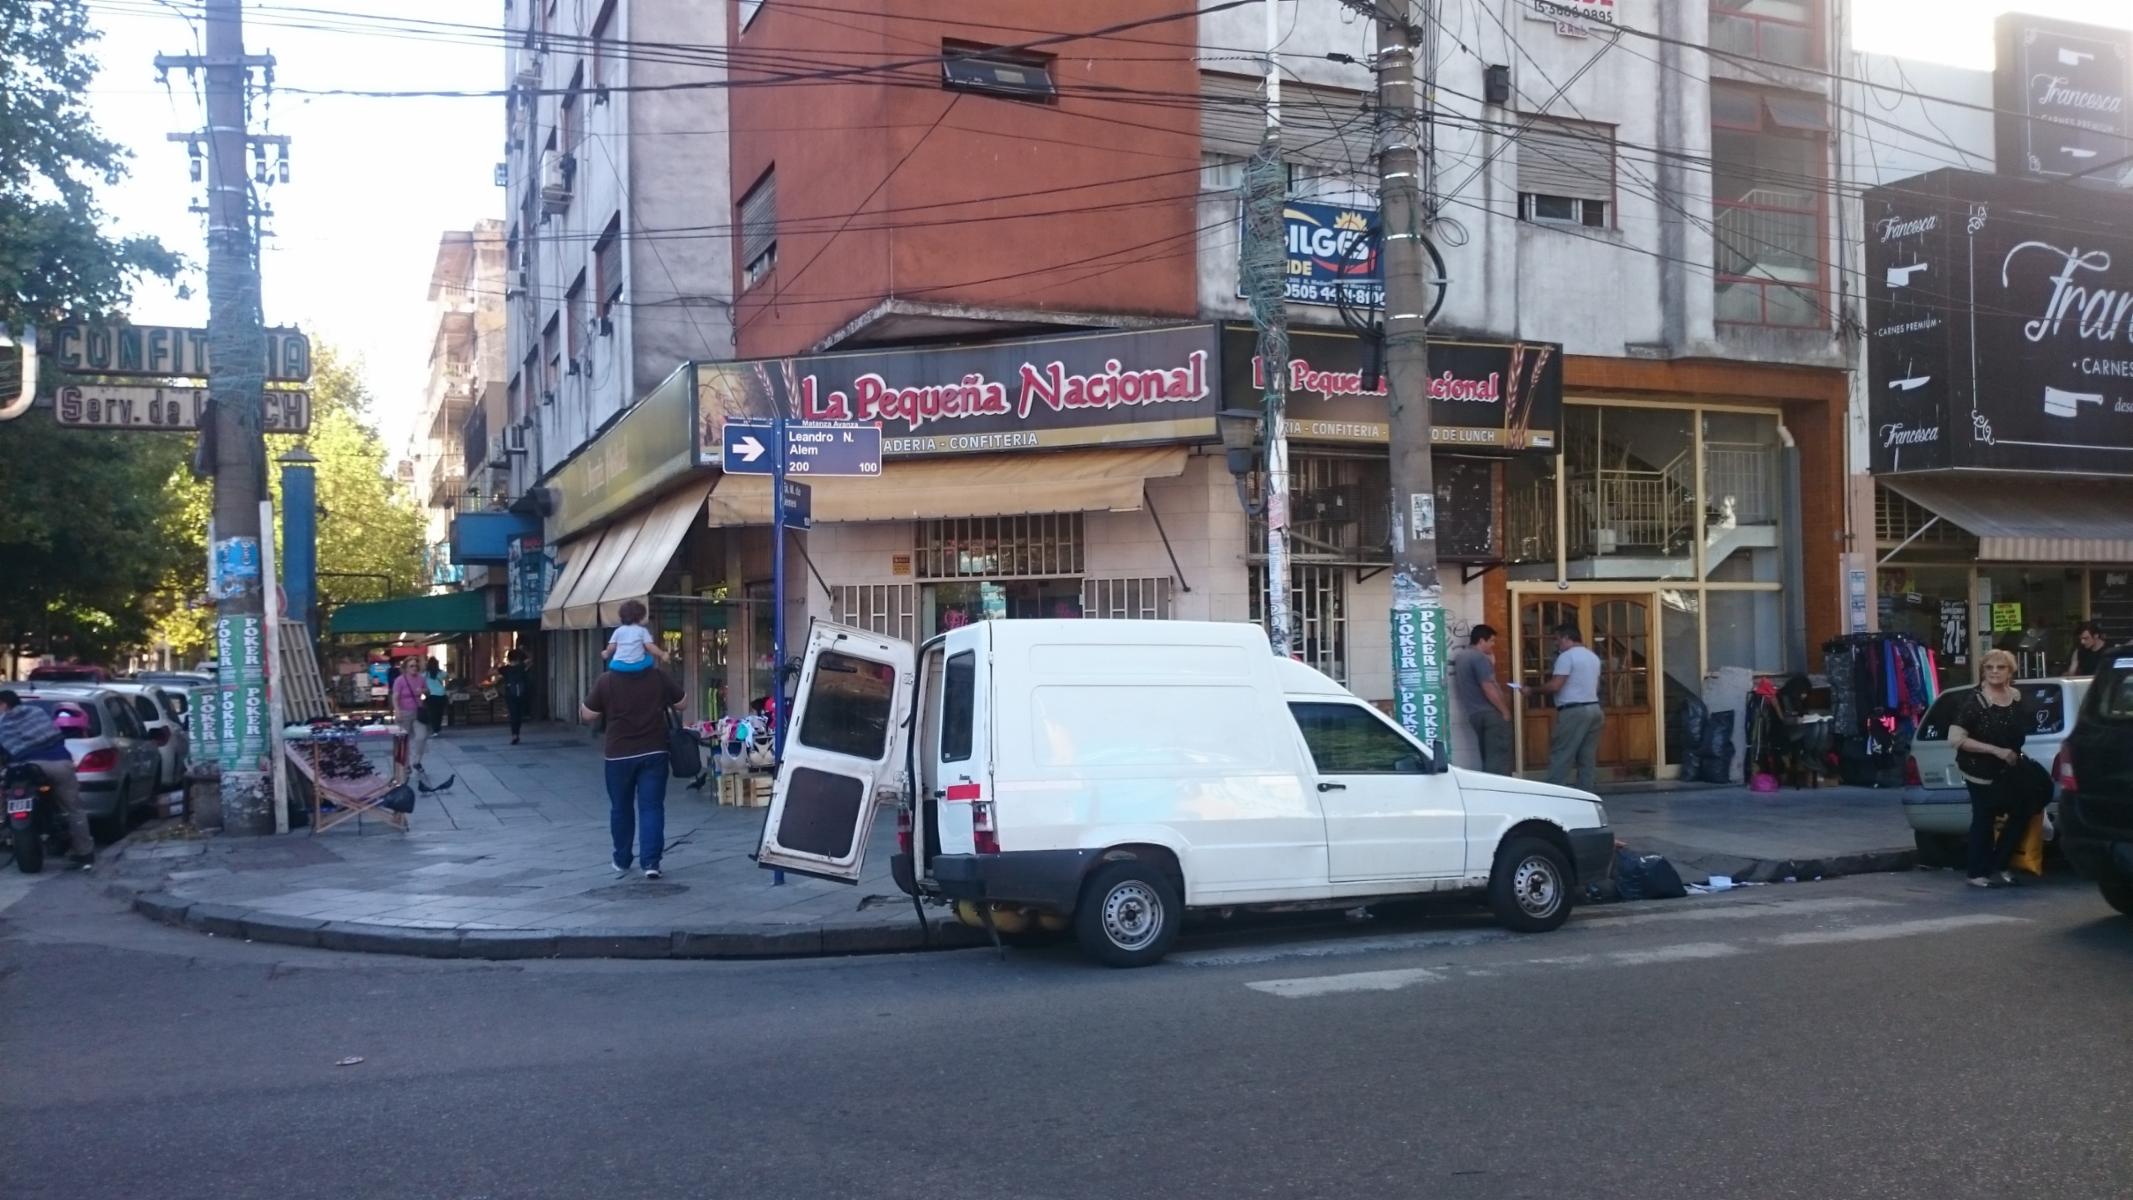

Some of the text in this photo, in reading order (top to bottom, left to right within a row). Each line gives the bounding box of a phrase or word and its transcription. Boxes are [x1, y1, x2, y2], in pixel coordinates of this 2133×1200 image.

[2031, 73, 2122, 112] Francesca
[1876, 215, 1936, 243] Francesca
[1878, 319, 1937, 337] CARNES PREMIUM
[56, 325, 312, 380] CONFITIA
[61, 386, 141, 423] Serv.
[150, 389, 180, 425] de
[802, 350, 1209, 432] La Pequeña Nacional
[789, 431, 854, 443] Leandro N.
[802, 420, 833, 428] Matanza
[950, 432, 1038, 449] CONFITERIA
[1311, 422, 1380, 438] CONFITERIA
[1442, 429, 1457, 440] DE
[1459, 430, 1495, 441] LUNCH
[1880, 422, 1939, 448] Francesca
[789, 444, 818, 455] Alem
[789, 462, 877, 473] 200 100
[218, 619, 233, 667] POKER
[244, 618, 260, 665] POKER
[1399, 612, 1418, 669] POKER
[1420, 610, 1437, 667] POKER
[201, 695, 217, 741] POKER
[222, 691, 235, 739] POKER
[246, 687, 261, 735] POKER
